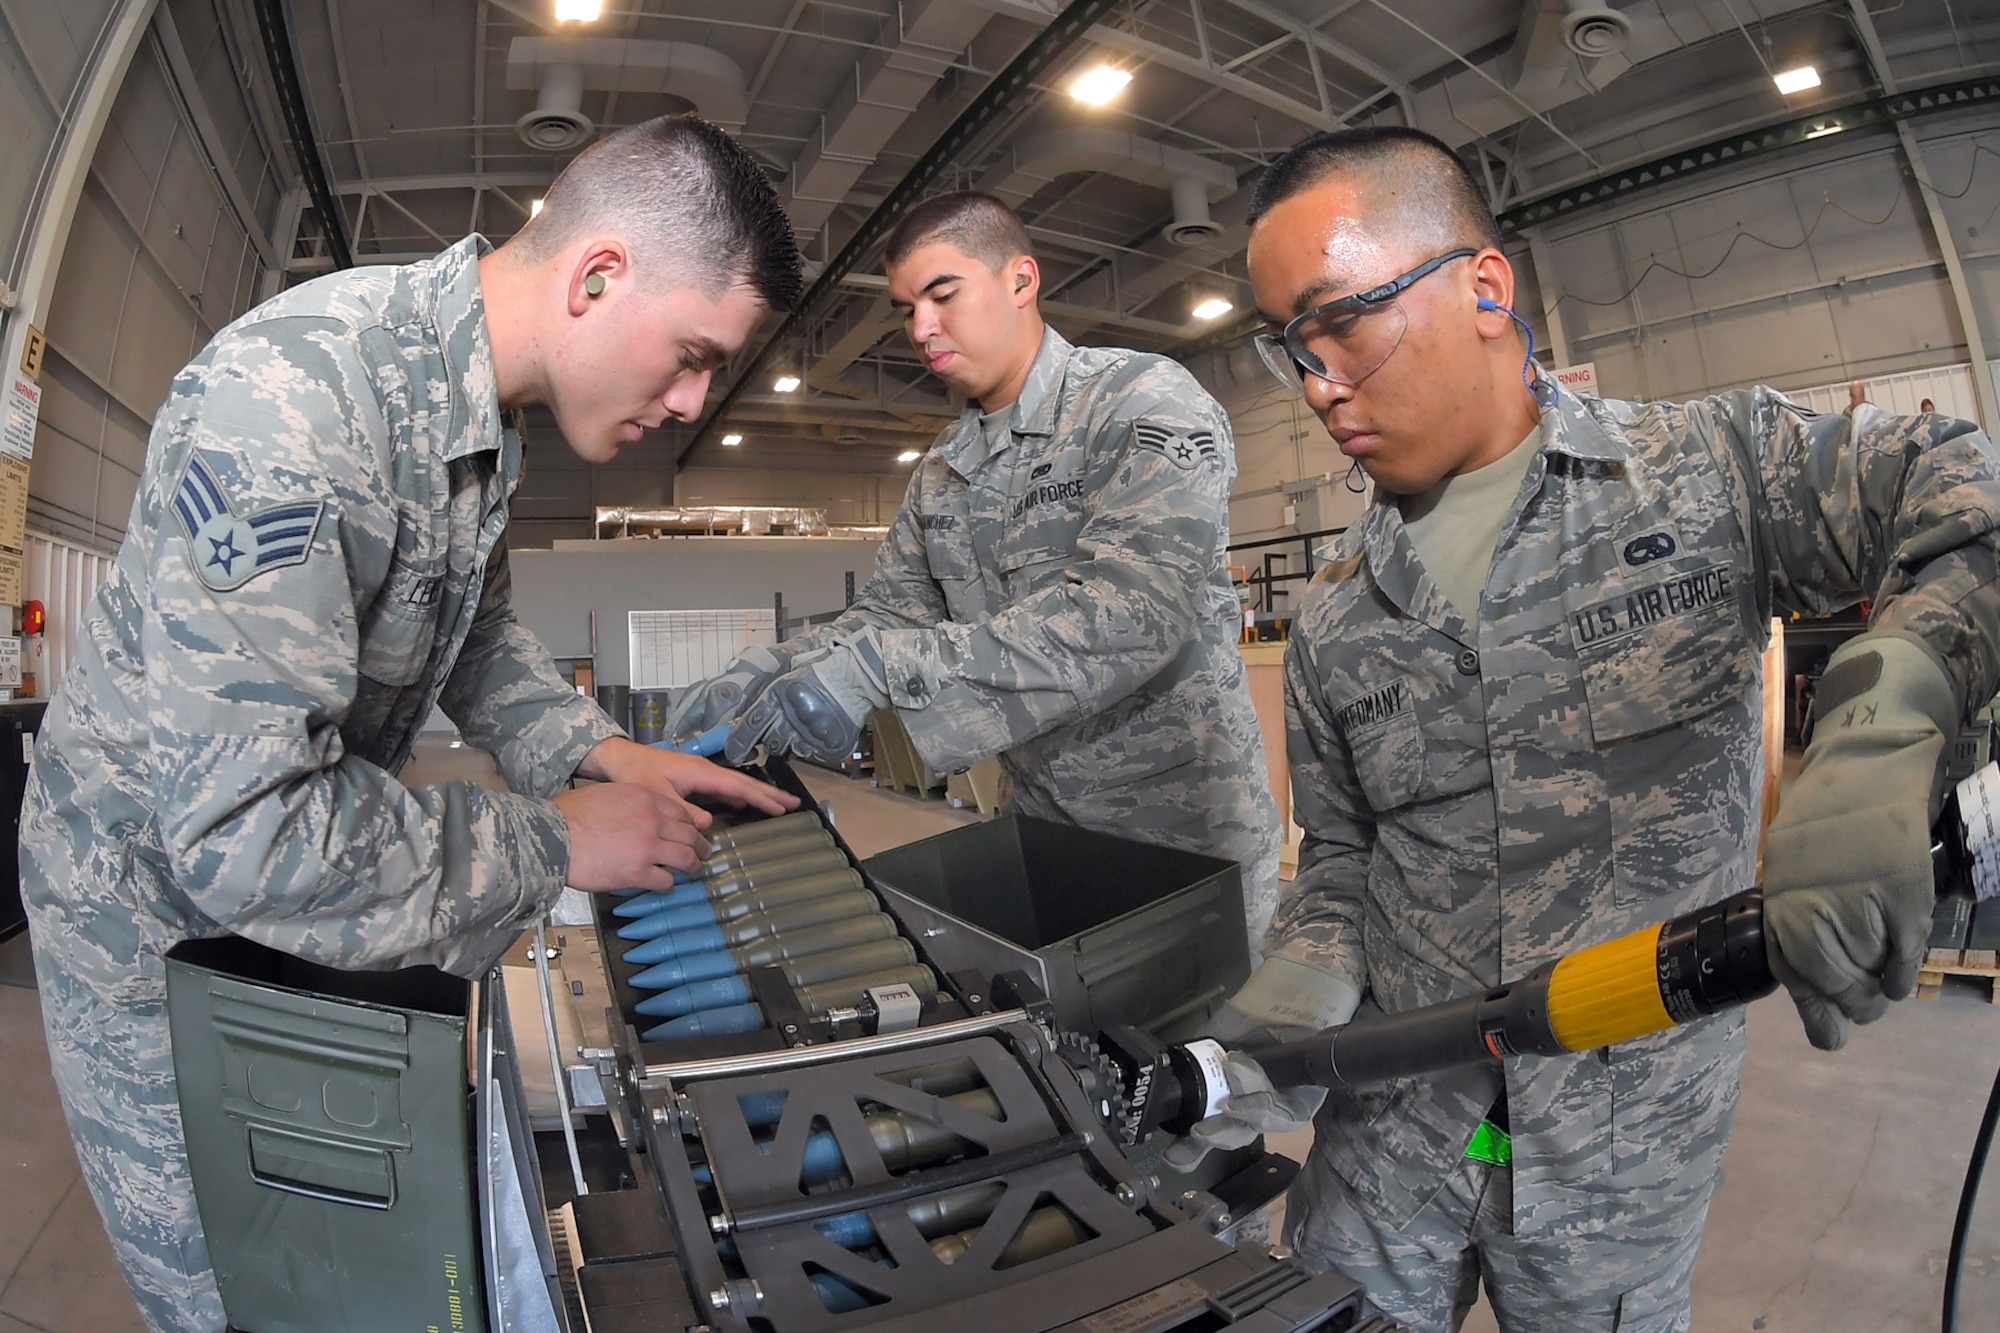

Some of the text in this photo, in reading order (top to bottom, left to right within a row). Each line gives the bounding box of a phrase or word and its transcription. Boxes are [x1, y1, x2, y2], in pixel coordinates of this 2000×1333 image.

[26, 335, 40, 370] E
[2, 455, 28, 474] EXPLOSIVE
[6, 470, 22, 484] LIMITS
[1039, 479, 1085, 505] FORCE
[1576, 567, 1732, 643] U.S. AIR FORCE
[1131, 1063, 1154, 1108] 0054
